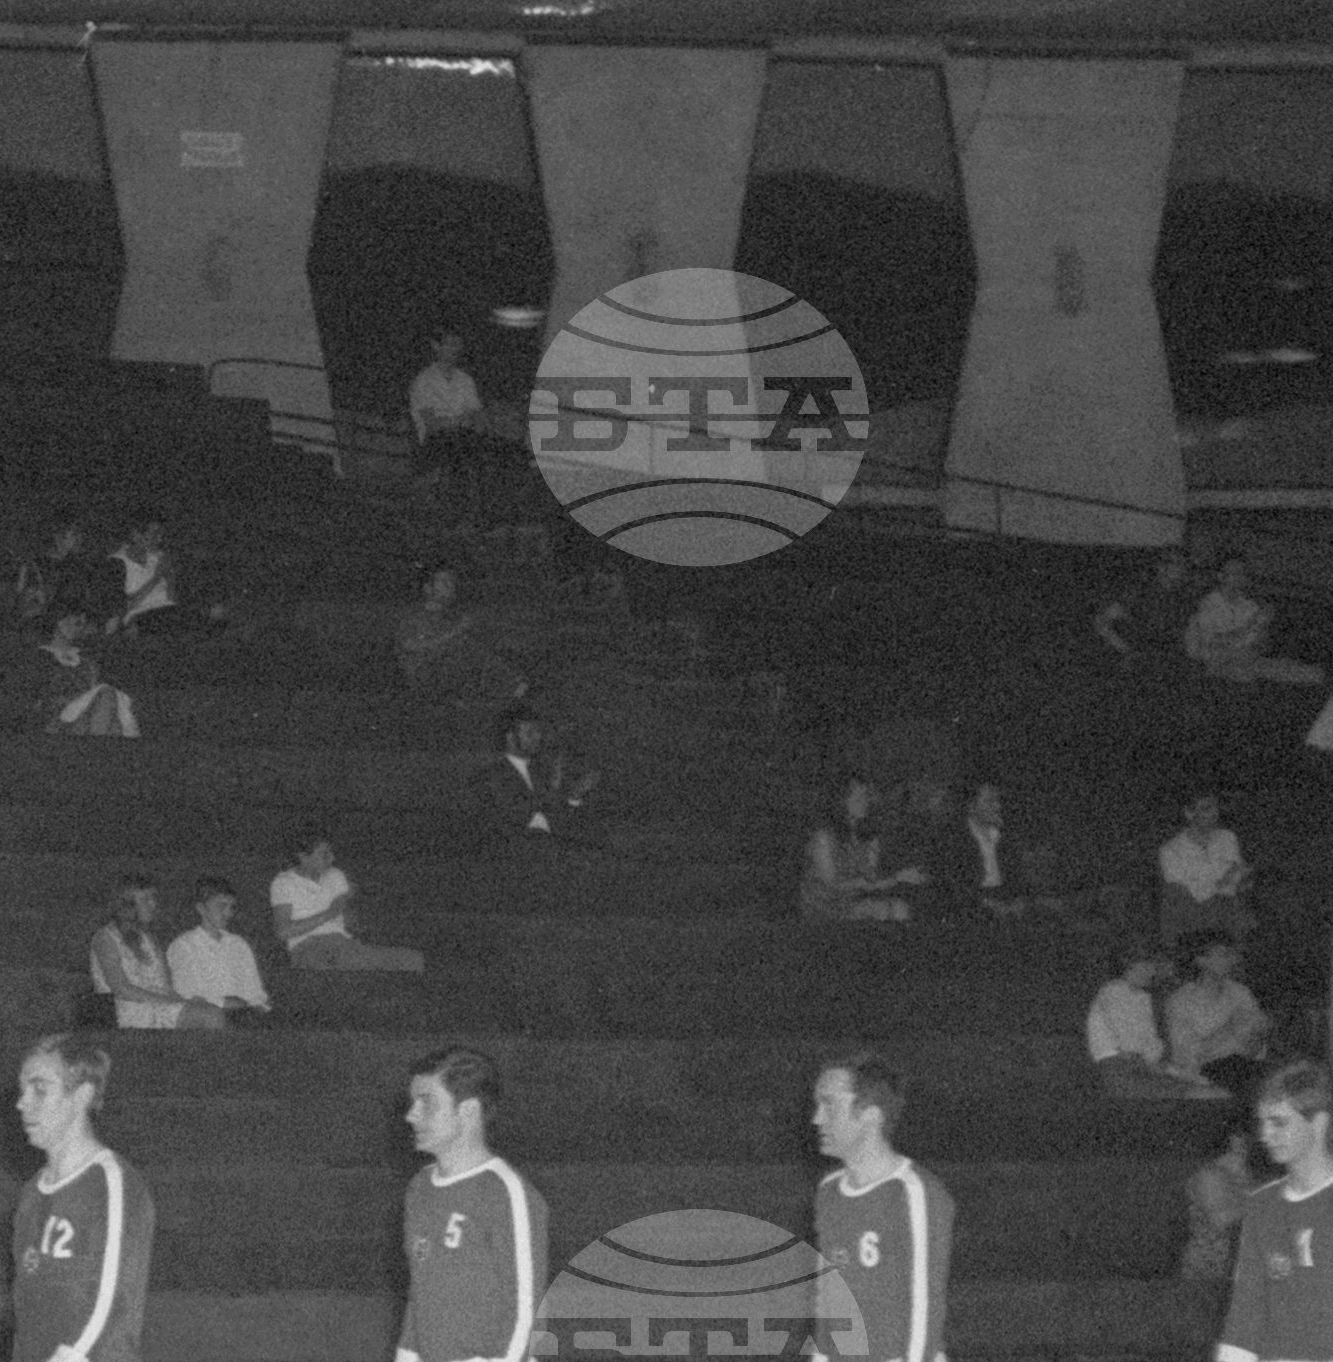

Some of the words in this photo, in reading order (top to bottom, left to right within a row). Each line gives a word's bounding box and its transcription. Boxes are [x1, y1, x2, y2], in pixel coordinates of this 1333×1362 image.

[41, 1215, 74, 1258] 12
[444, 1212, 465, 1248] 5
[1297, 1228, 1314, 1267] 1
[859, 1231, 879, 1267] 6
